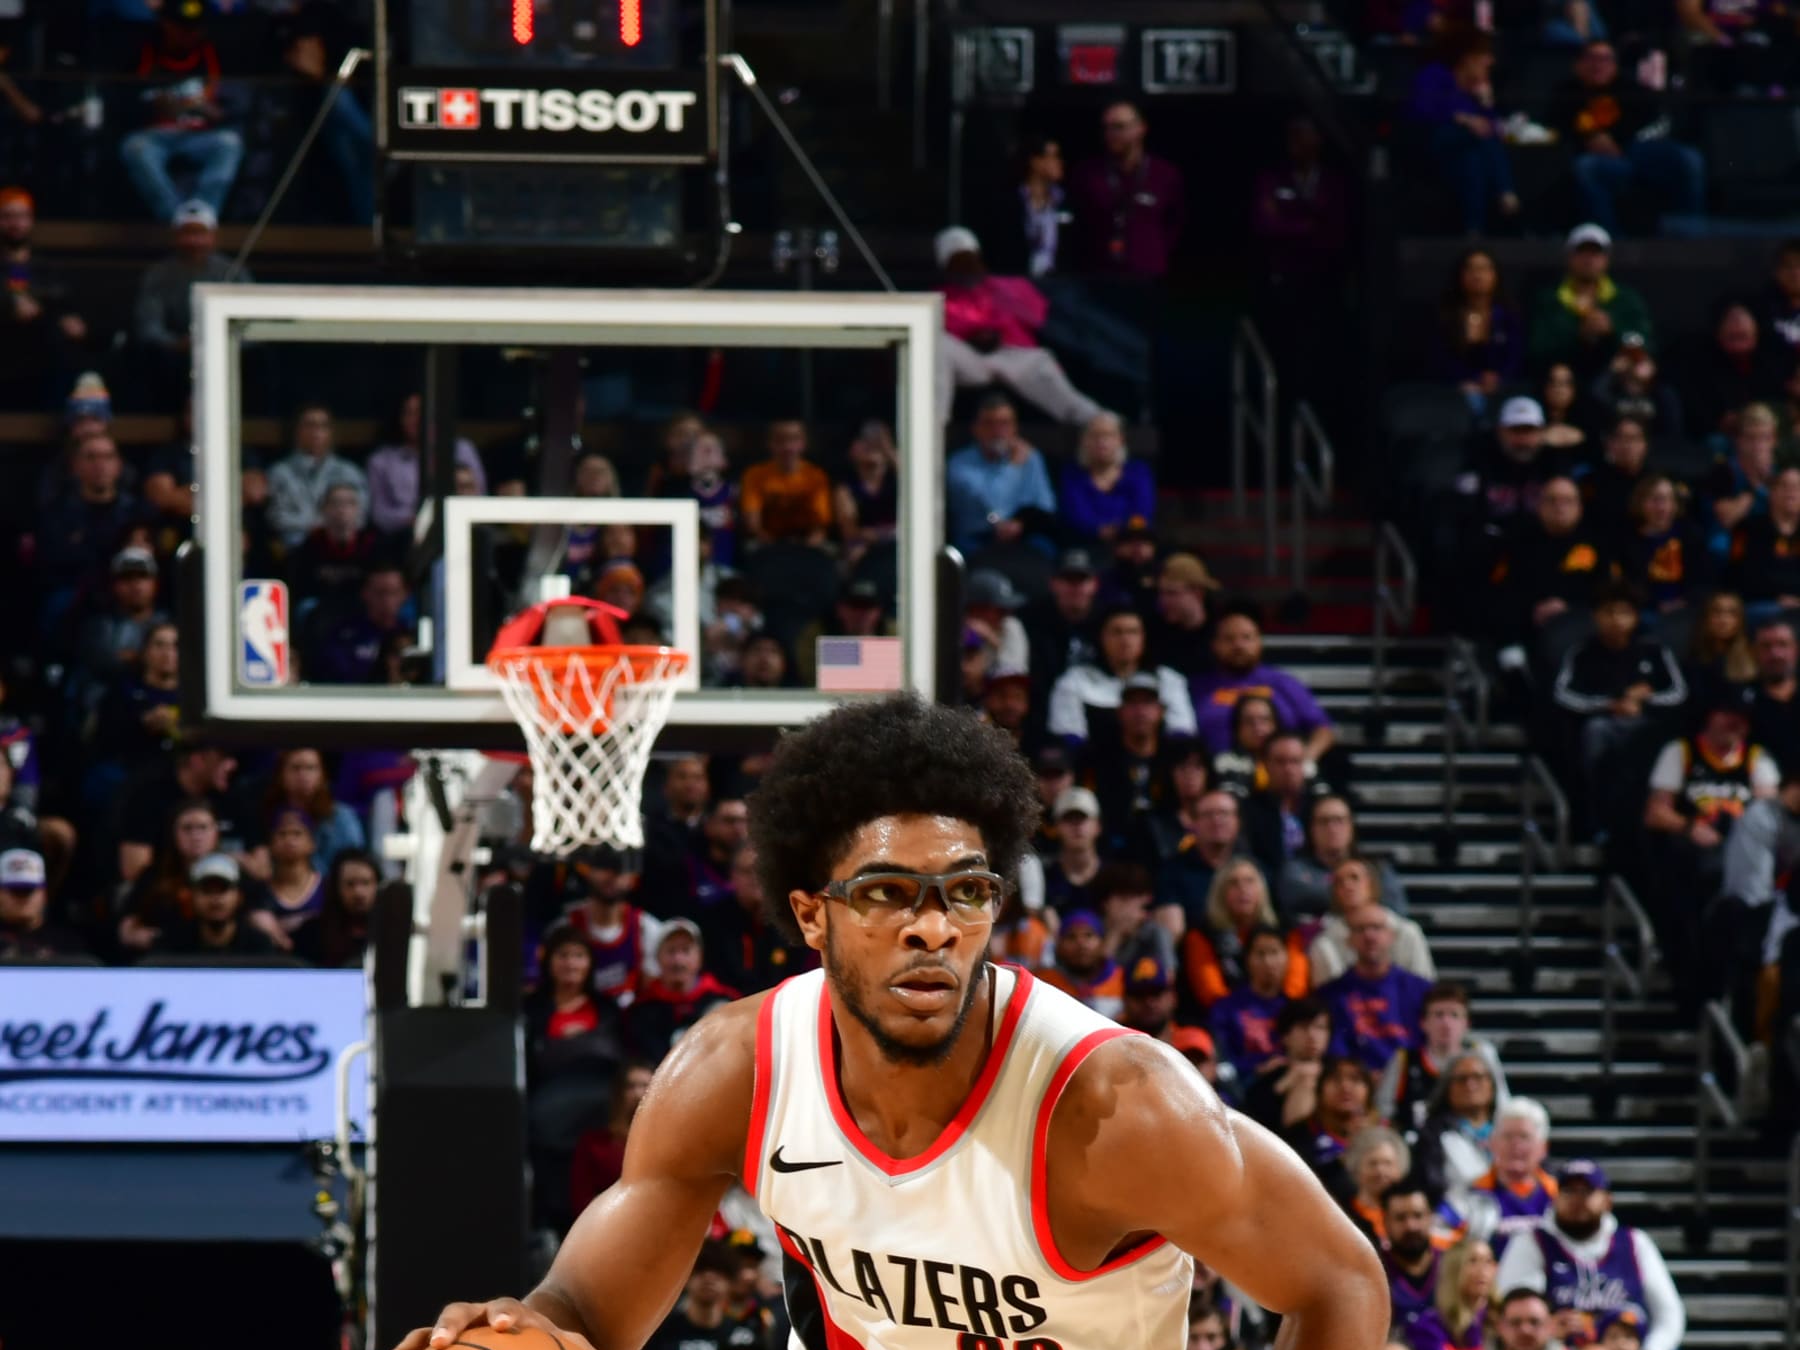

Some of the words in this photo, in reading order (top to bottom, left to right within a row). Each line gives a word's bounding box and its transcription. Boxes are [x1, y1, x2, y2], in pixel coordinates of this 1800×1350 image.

[481, 88, 697, 133] TISSOT
[105, 999, 319, 1064] James
[144, 1093, 311, 1115] ATTORNEYS
